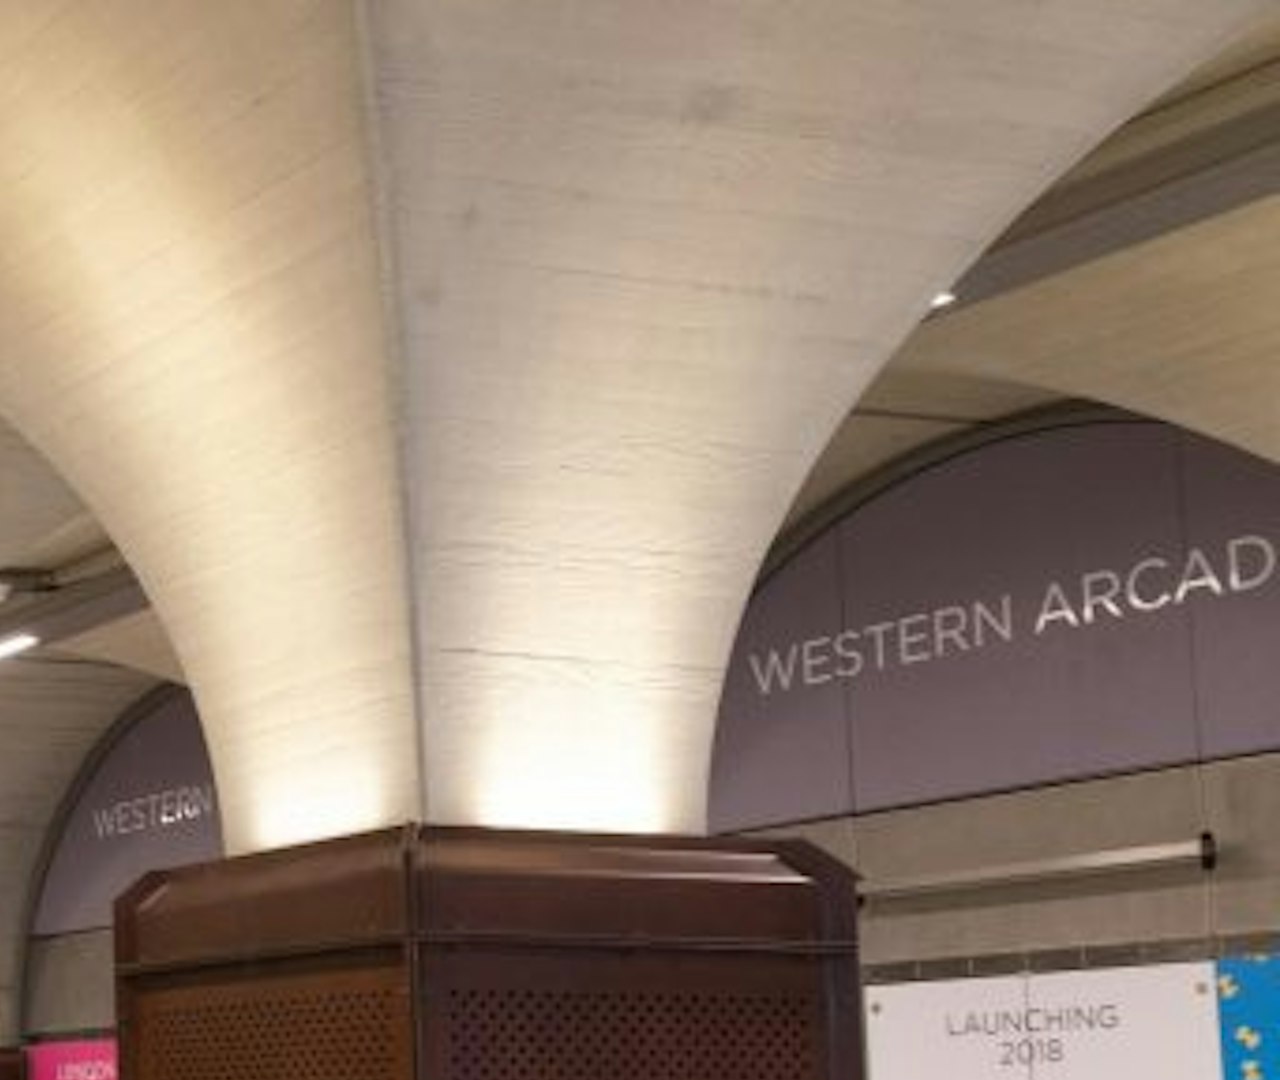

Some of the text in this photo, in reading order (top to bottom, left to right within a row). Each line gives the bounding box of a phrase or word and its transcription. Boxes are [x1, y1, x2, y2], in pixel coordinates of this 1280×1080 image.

[748, 535, 1277, 695] WESTERN ARCAD
[92, 786, 210, 839] WESTERN
[946, 1003, 1120, 1036] LAUNCHING
[997, 1038, 1065, 1066] 2018
